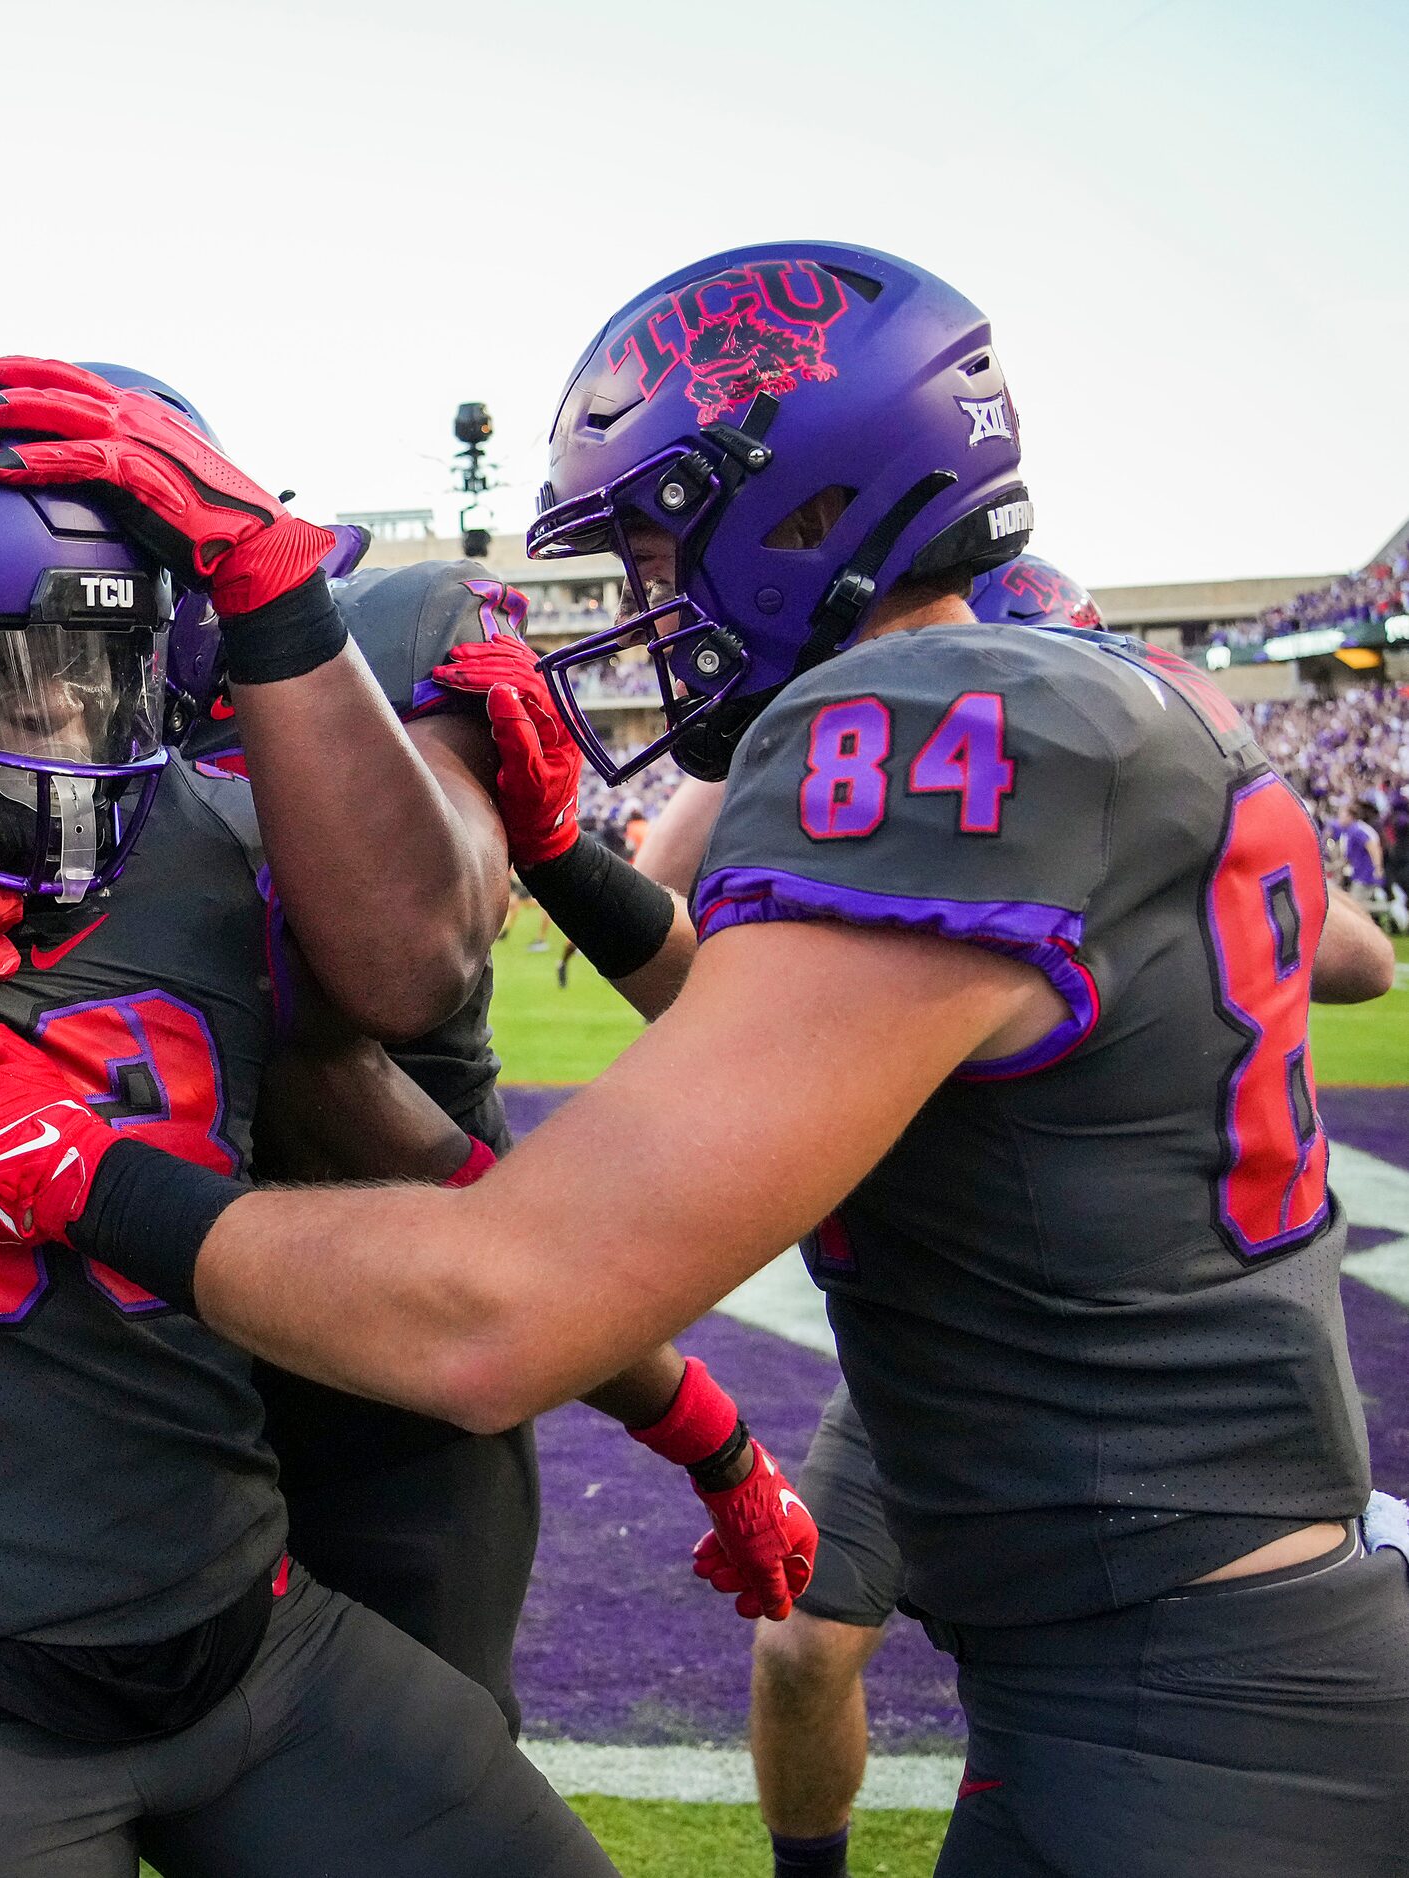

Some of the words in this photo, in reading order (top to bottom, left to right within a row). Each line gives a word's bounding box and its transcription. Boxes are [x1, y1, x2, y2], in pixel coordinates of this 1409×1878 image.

[606, 259, 848, 403] TCU
[79, 577, 134, 608] TCU
[798, 690, 1018, 844] 84
